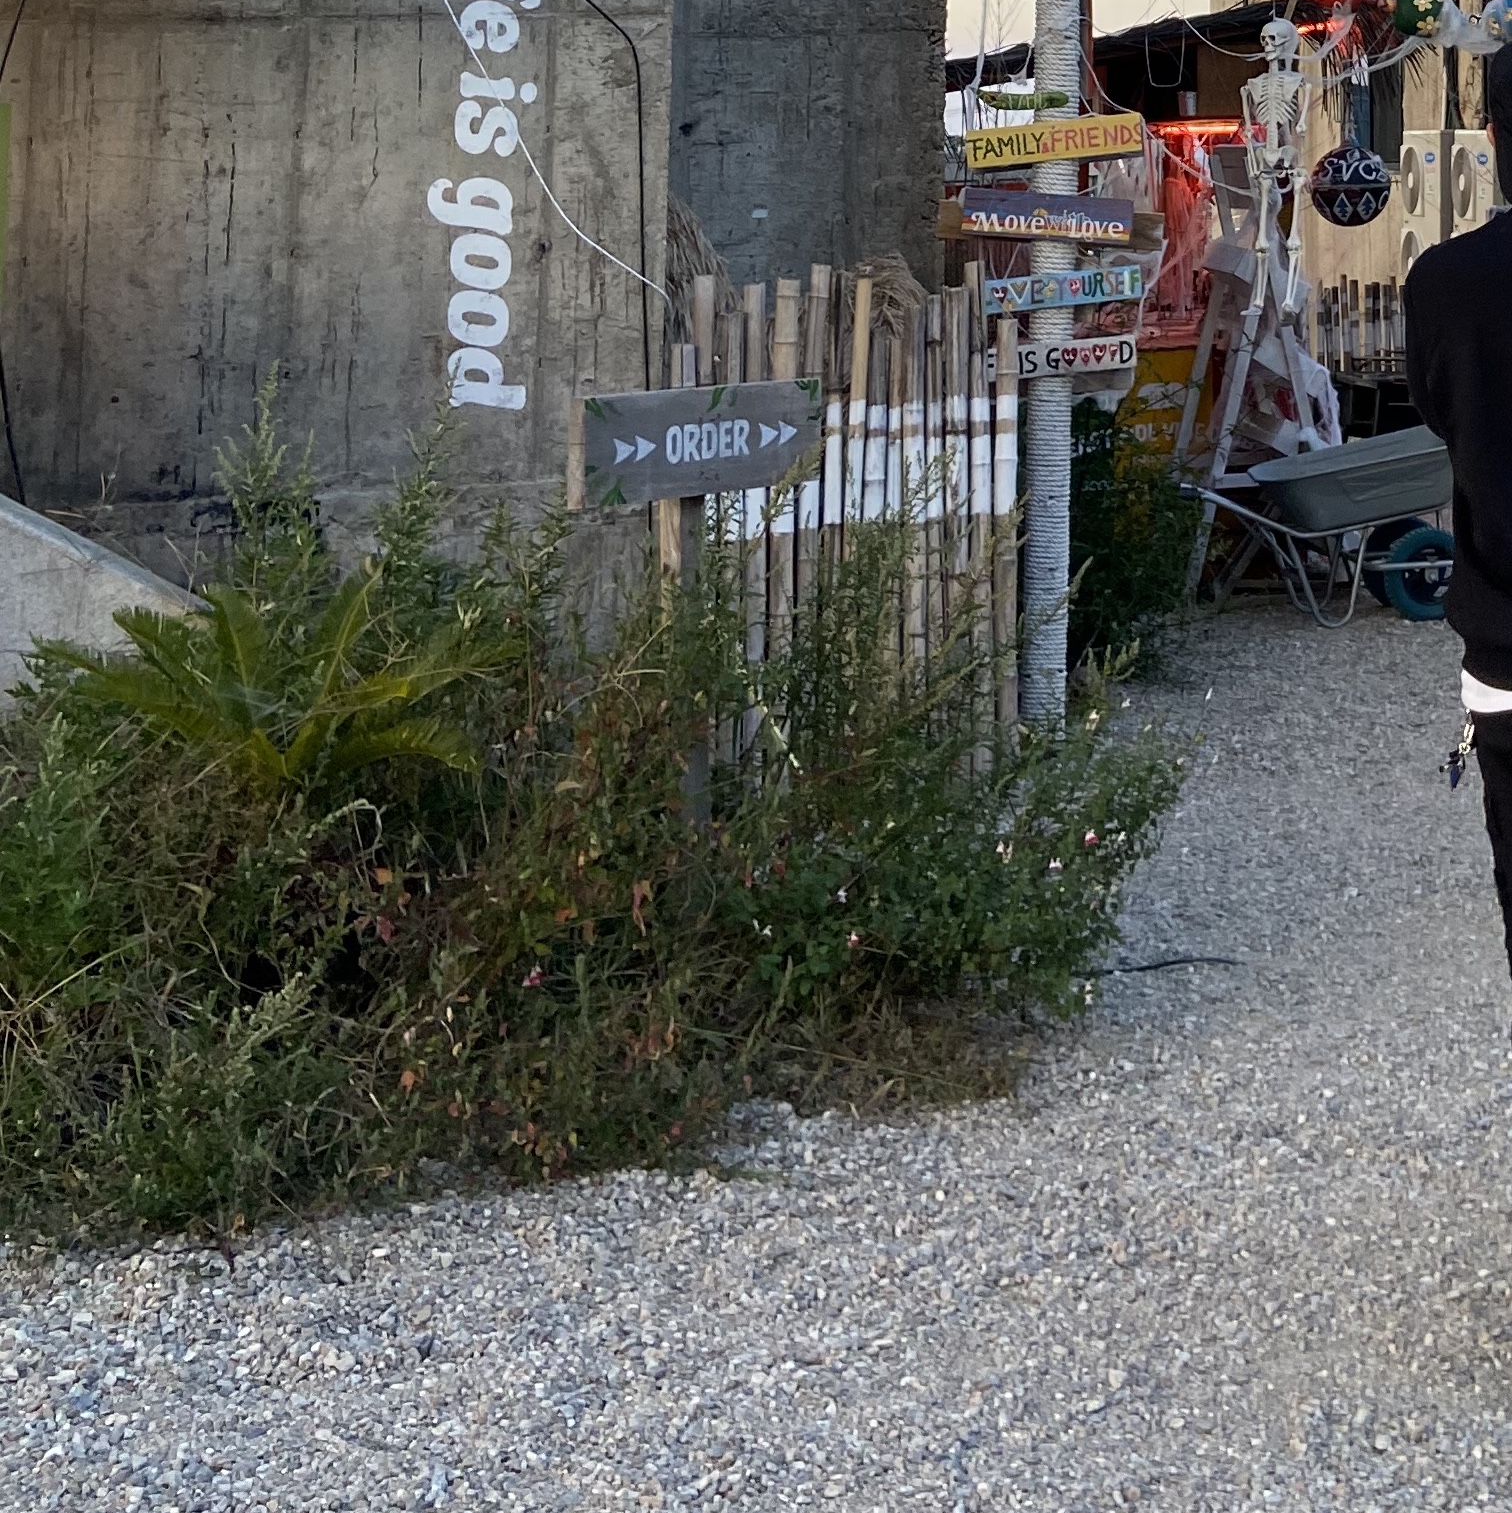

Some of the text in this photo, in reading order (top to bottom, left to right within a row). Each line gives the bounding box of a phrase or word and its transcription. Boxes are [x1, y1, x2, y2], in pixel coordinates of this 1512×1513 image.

[454, 70, 538, 158] is
[966, 131, 1046, 163] FAMILY
[1049, 123, 1143, 154] FRIENDS
[970, 210, 1046, 235] Move
[426, 176, 527, 411] good
[665, 423, 750, 466] ORDER
